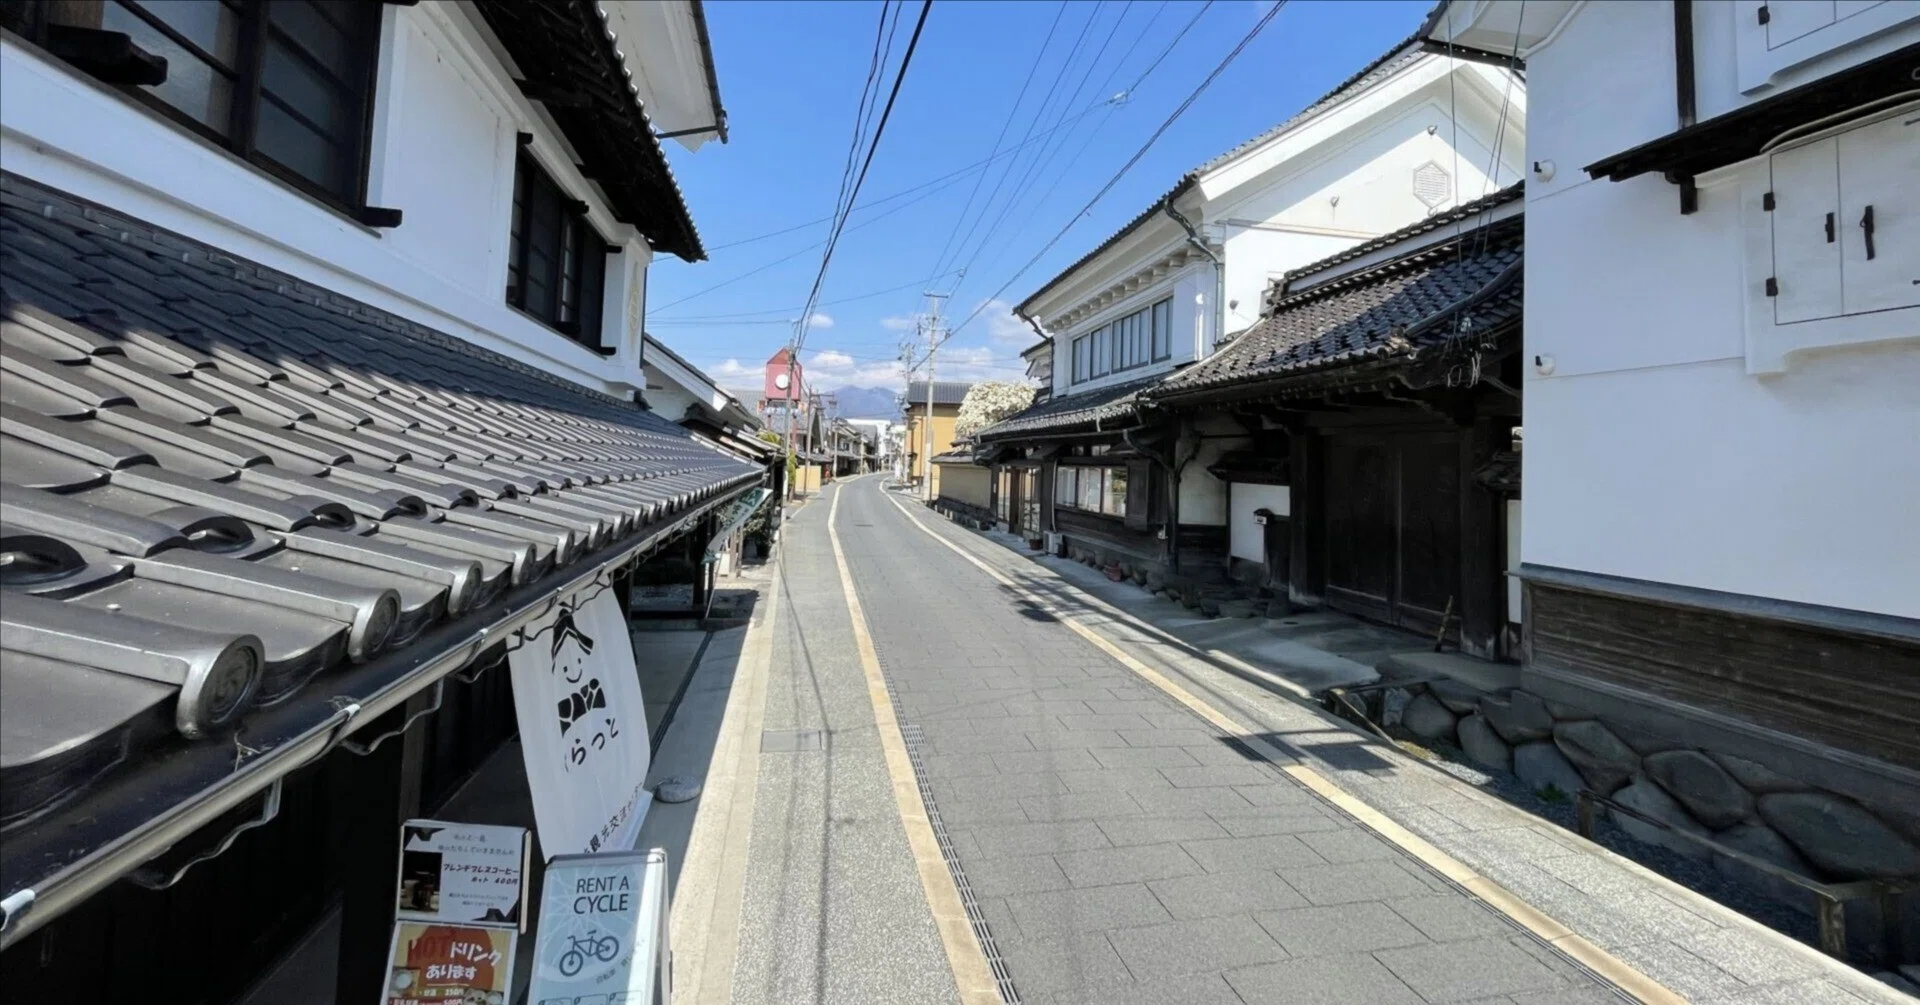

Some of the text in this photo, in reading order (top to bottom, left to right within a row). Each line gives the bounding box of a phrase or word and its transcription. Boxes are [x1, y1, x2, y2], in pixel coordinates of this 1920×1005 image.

[576, 875, 630, 894] RENT A
[573, 893, 629, 915] CYCLE
[450, 941, 502, 967] ドリンク
[426, 963, 477, 980] あります
